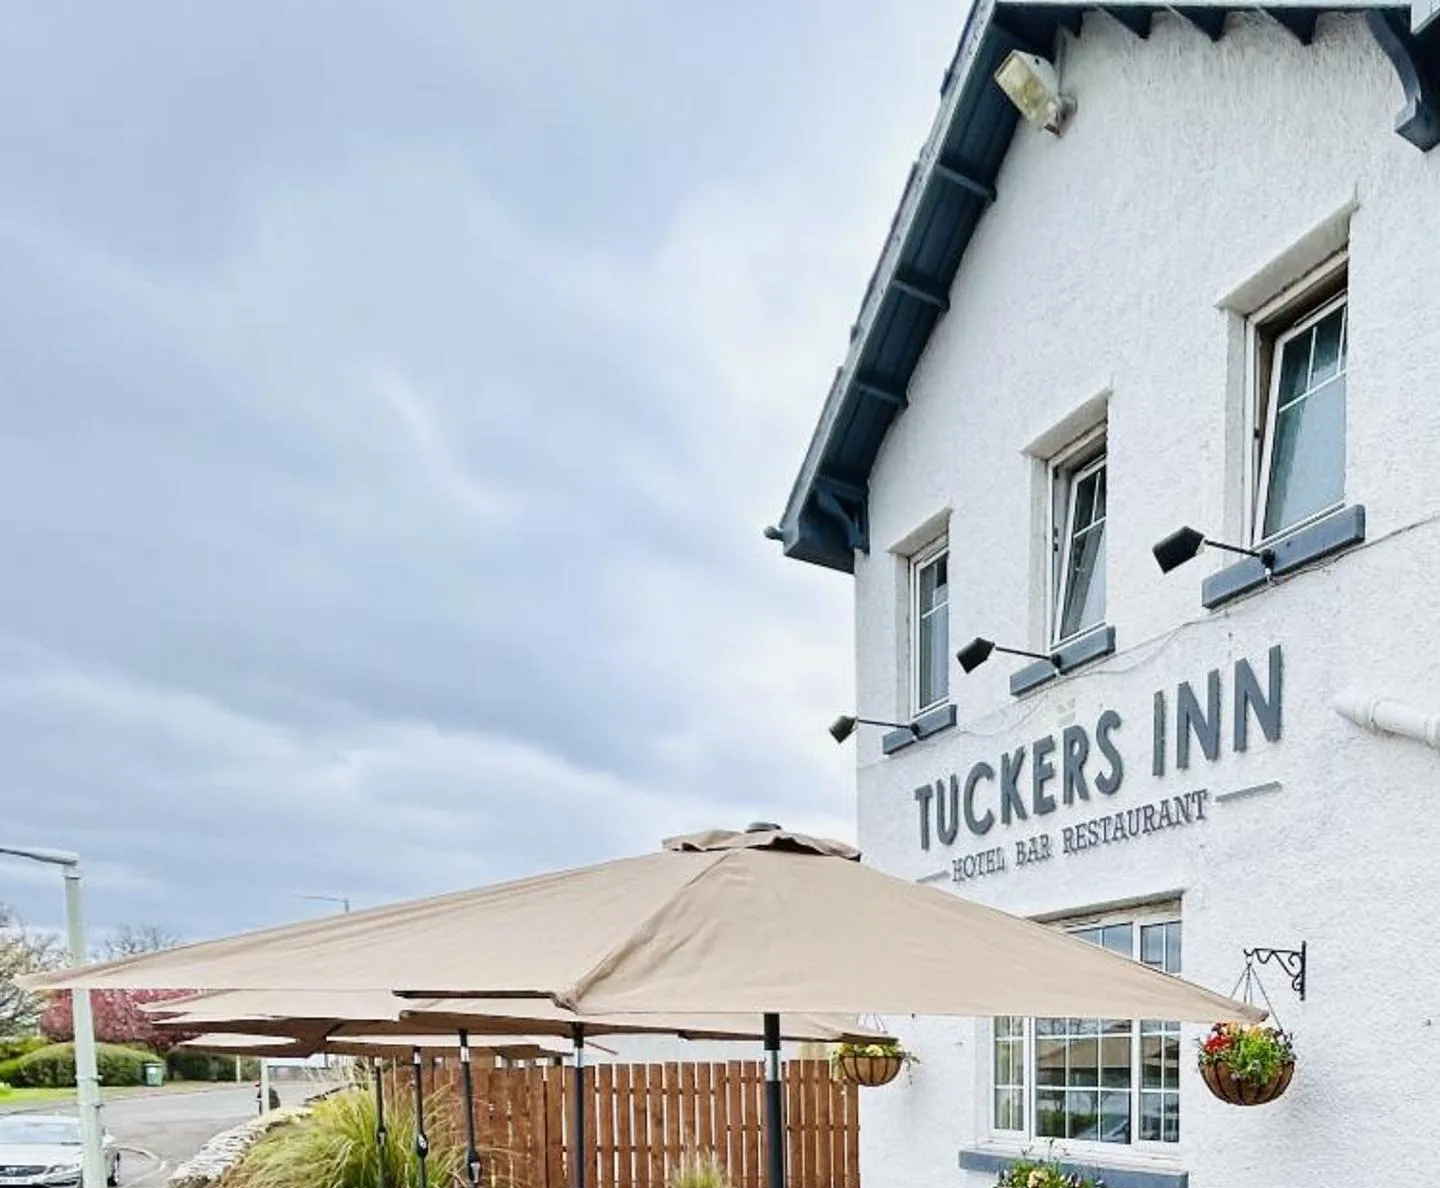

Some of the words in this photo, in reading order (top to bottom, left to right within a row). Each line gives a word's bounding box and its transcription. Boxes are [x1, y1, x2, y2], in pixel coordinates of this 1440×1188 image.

[914, 710, 1123, 850] TUCKERS
[1152, 644, 1282, 776] INN
[952, 847, 1005, 882] HOTEL
[1016, 835, 1051, 867] BAR
[1062, 789, 1209, 854] RESTAURANT
